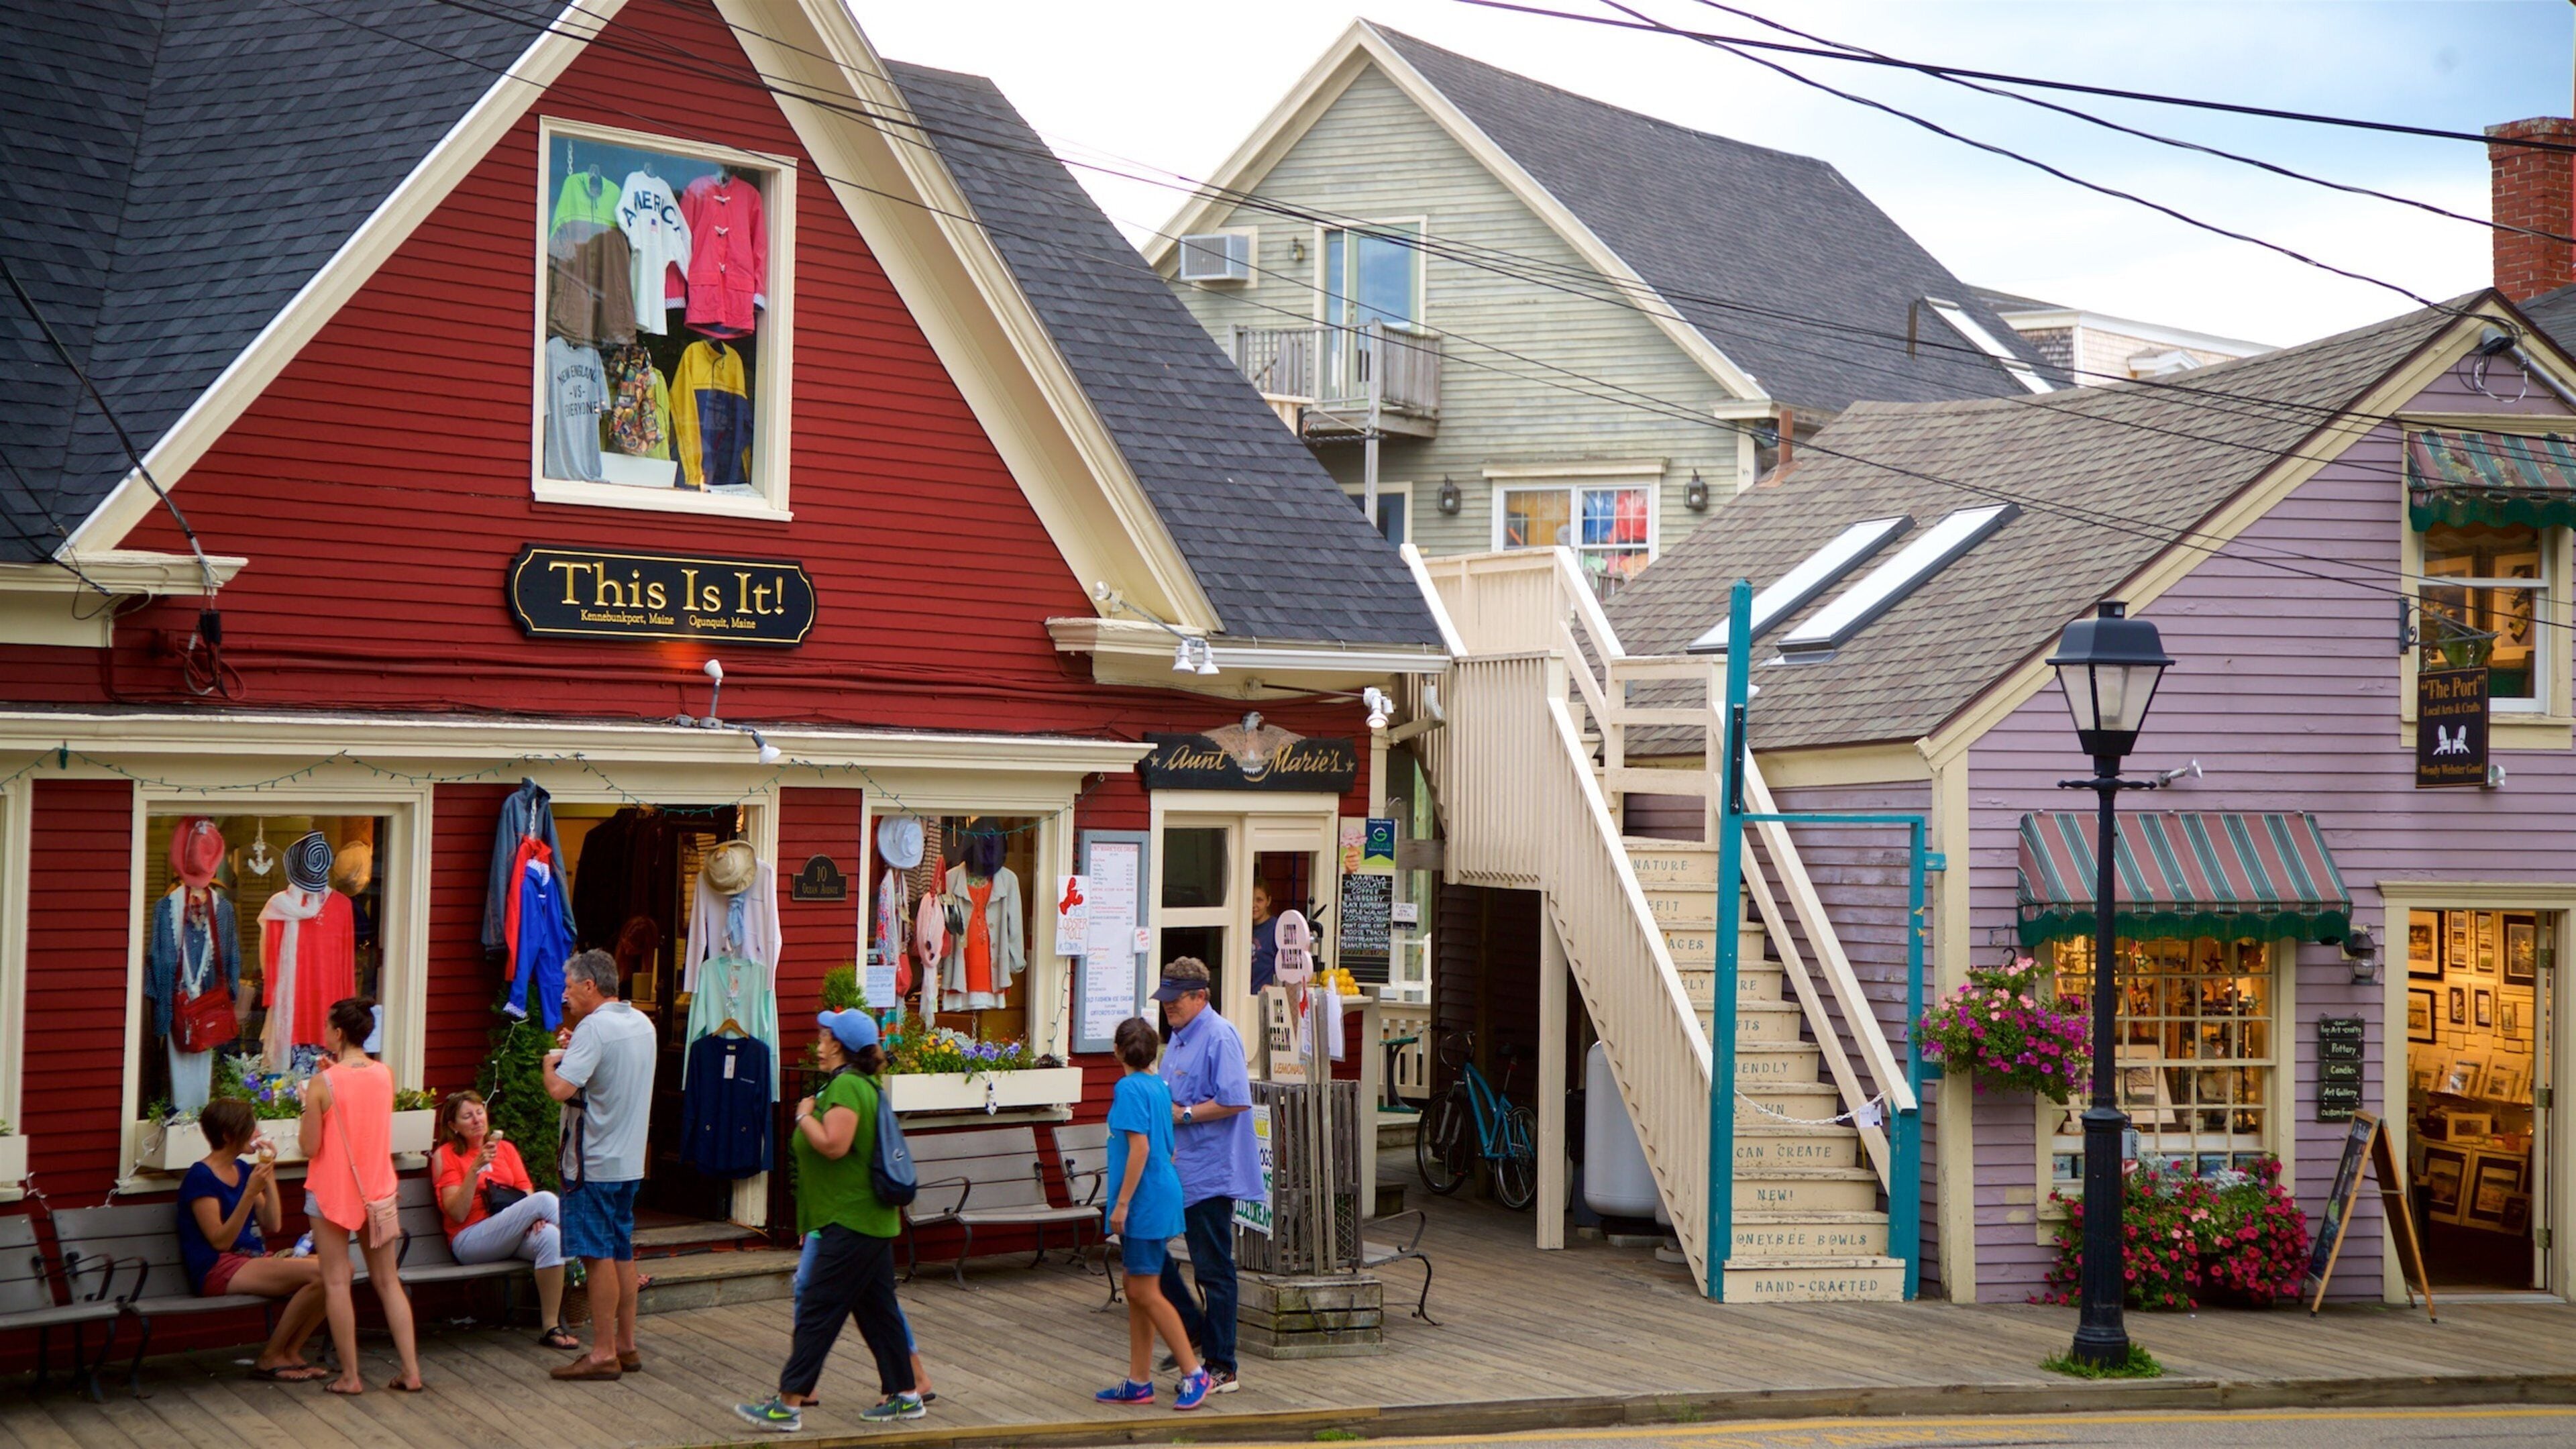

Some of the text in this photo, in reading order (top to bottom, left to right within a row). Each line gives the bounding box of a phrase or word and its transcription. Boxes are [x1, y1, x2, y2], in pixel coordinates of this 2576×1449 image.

[548, 560, 785, 615] This Is It!
[580, 609, 756, 629] Kennebunkport, Maine Ogunquit, Maine
[2424, 702, 2481, 716] Local Arts & Crafts
[1163, 743, 1344, 782] Aunt Marie's
[1633, 859, 1688, 871] NATURE
[816, 865, 827, 882] 10
[1344, 881, 1387, 889] CHOCOLATE
[1648, 900, 1679, 912] EFIT
[1059, 918, 1088, 931] LOBSTER
[1668, 939, 1704, 950] AGES
[1735, 1020, 1760, 1031] FTS
[2331, 1042, 2357, 1056] Pottery
[1274, 1063, 1306, 1075] LEMONAD
[1735, 1062, 1788, 1073] IENDLY
[2330, 1065, 2356, 1075] Candles
[2323, 1087, 2358, 1099] Art Gallery
[1260, 1148, 1272, 1168] OGS
[1737, 1146, 1831, 1158] CAN CREATE
[1758, 1189, 1793, 1201] NEW!
[1736, 1233, 1867, 1246] ONEYBEE BOWLS
[1755, 1280, 1878, 1293] HAND-CRAFTED
